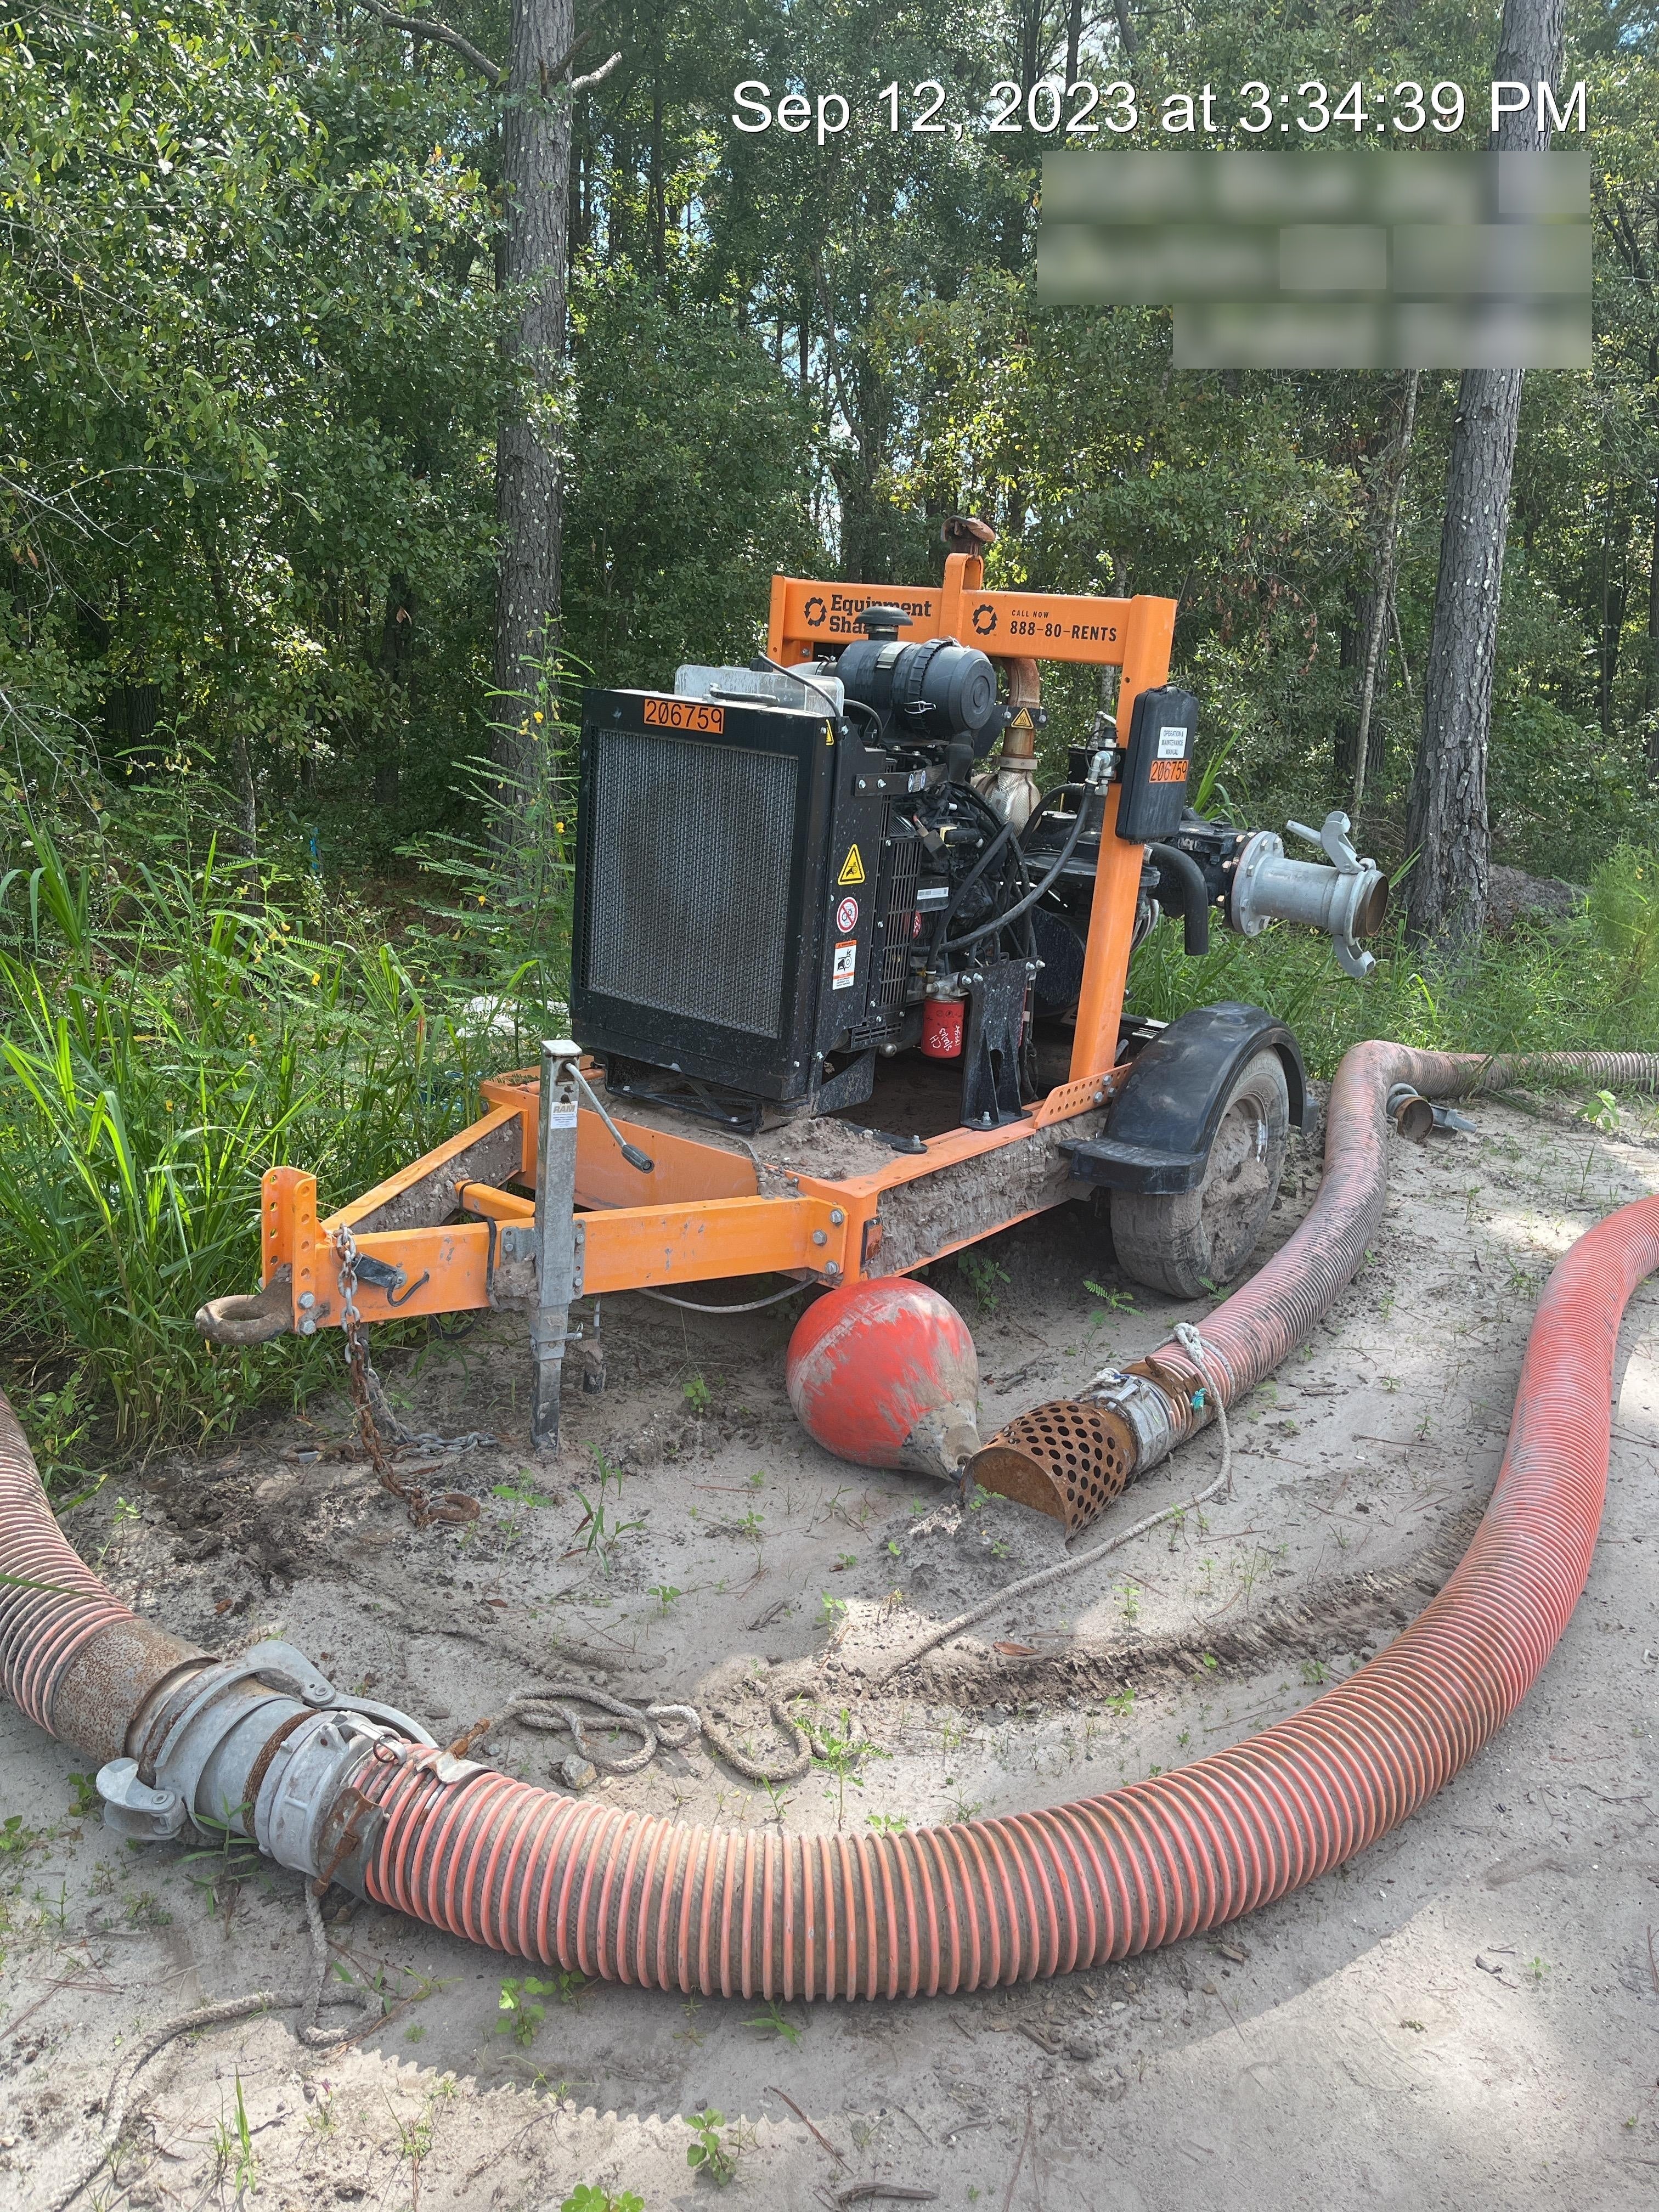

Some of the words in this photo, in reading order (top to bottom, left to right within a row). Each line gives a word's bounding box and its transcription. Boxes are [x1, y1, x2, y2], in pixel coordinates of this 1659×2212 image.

[1010, 620, 1117, 642] 888-80-RENTS
[646, 700, 722, 732] 206759
[1150, 761, 1187, 781] 206759
[553, 1105, 575, 1113] RAM
